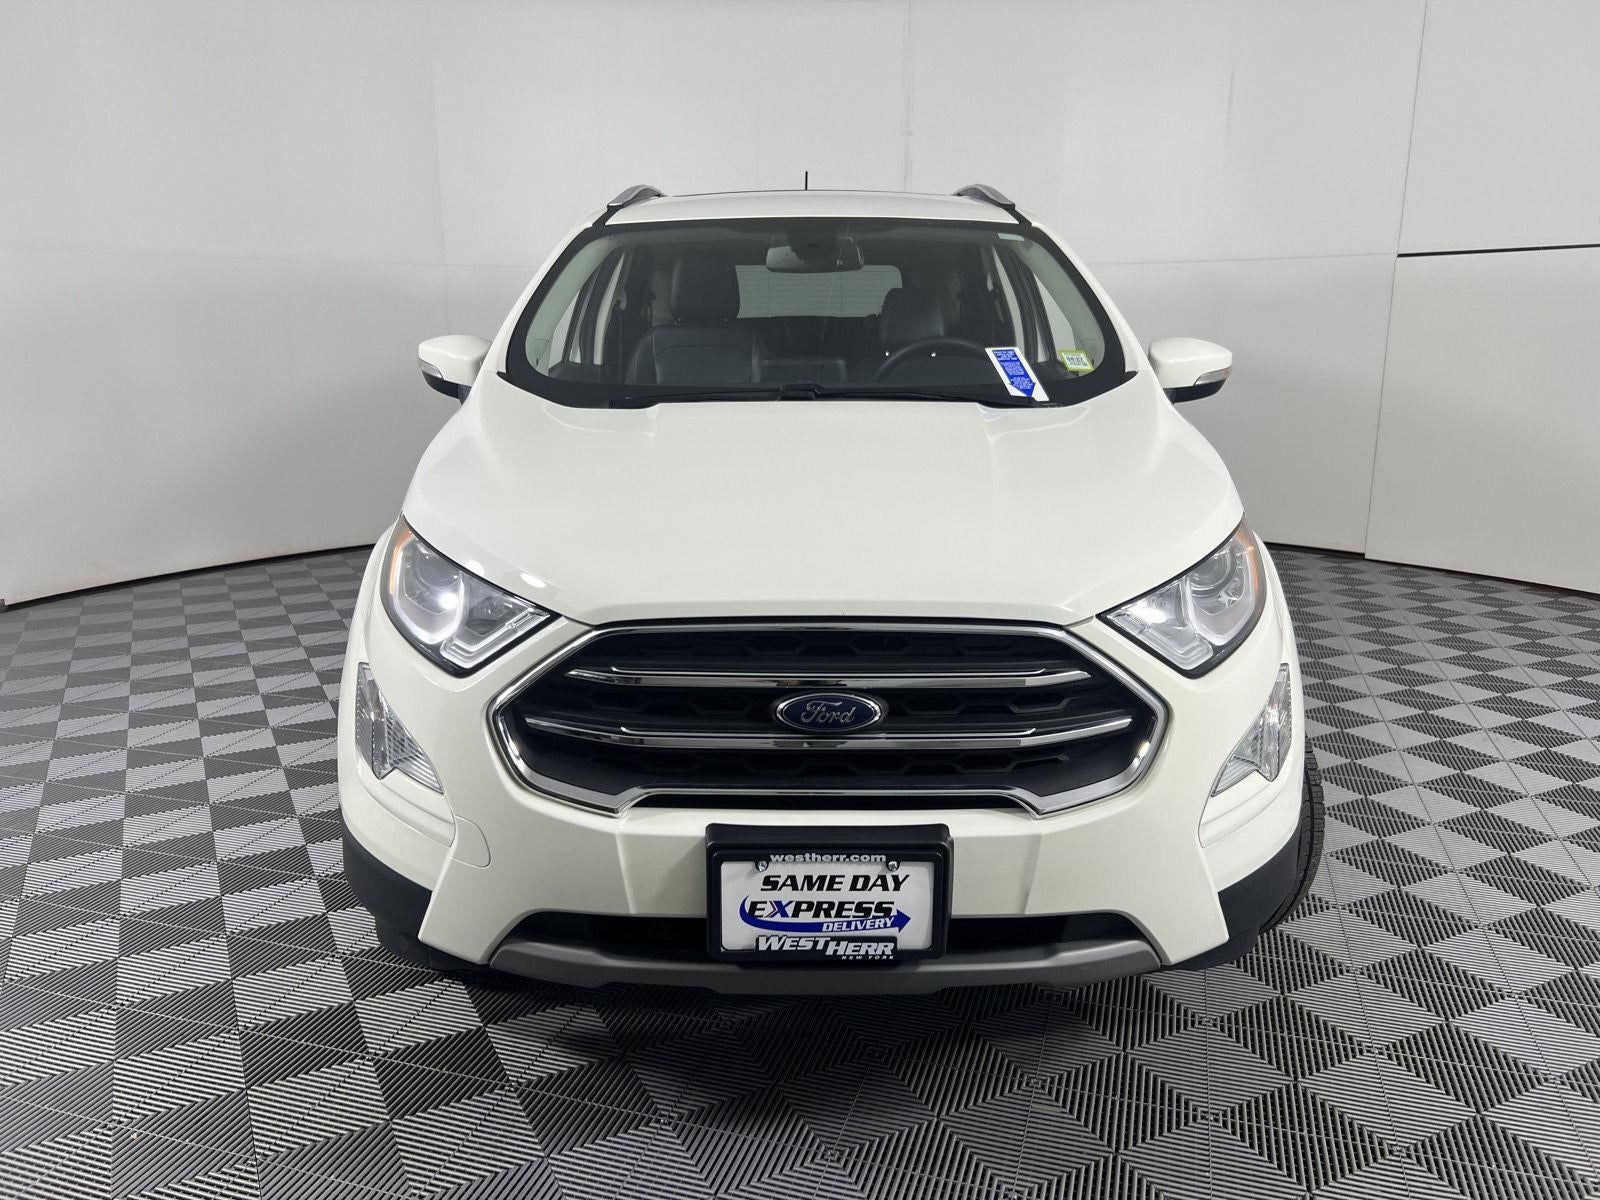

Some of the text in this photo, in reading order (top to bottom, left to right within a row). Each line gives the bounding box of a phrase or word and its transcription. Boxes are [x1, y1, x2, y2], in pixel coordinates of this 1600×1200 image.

[801, 700, 856, 723] Ford
[770, 852, 886, 863] westherr.com
[761, 874, 910, 892] SAME DAY
[749, 900, 895, 919] EXPRESS
[822, 917, 895, 933] DELIVERY
